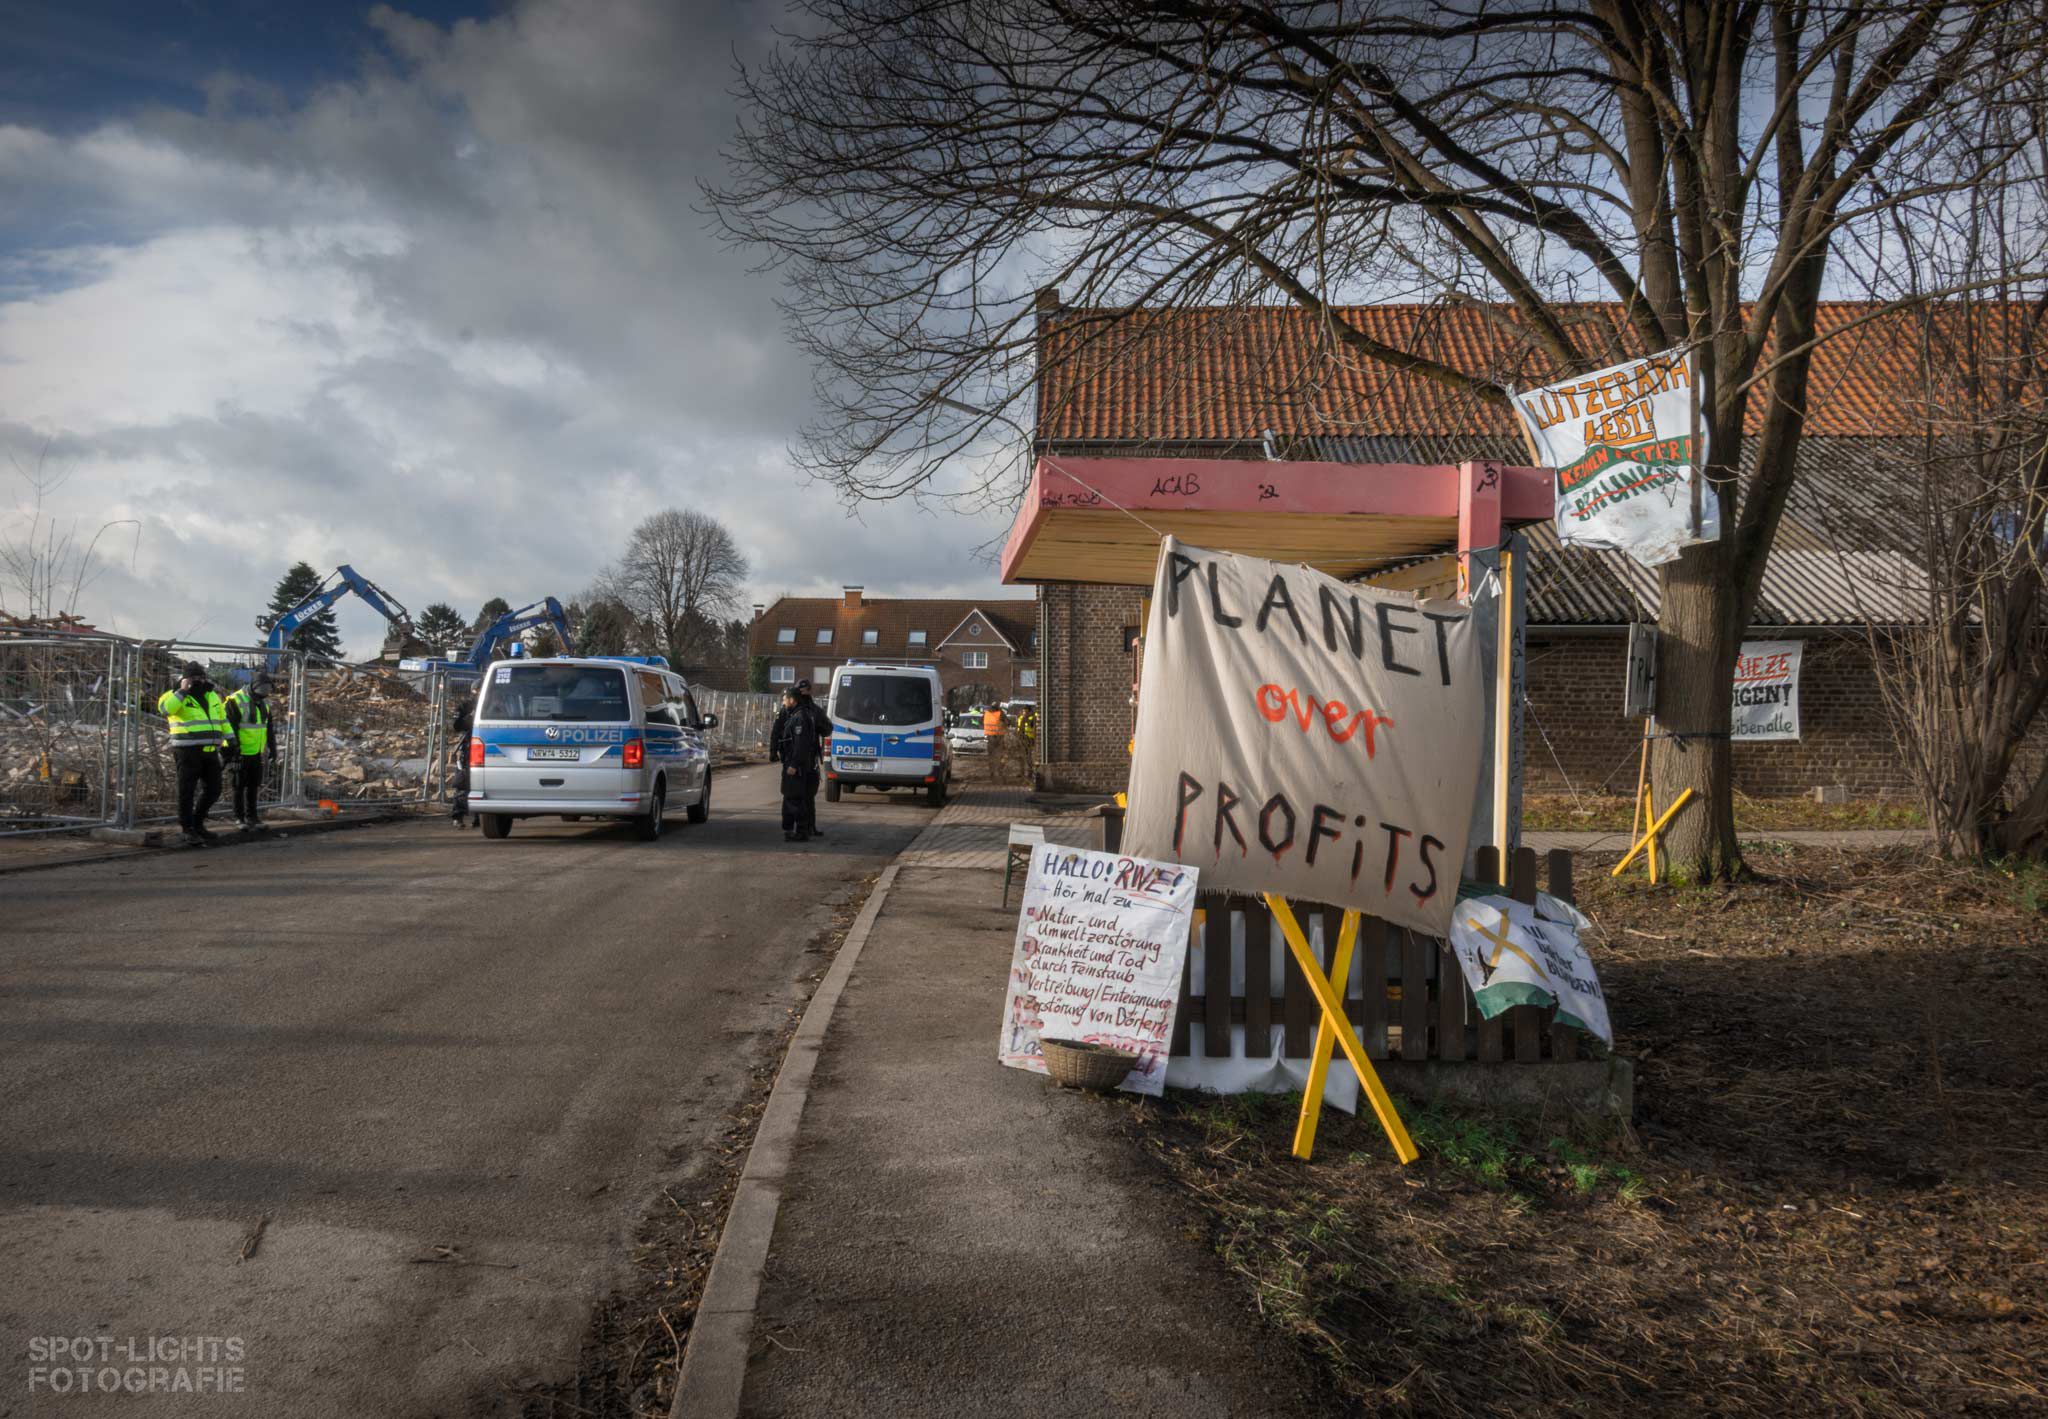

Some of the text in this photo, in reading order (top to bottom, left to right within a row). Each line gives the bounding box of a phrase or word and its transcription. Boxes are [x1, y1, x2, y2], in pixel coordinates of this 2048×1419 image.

[1584, 400, 1655, 446] LEBT!
[1151, 473, 1200, 497] ACAB
[1167, 552, 1464, 686] PLANET
[1733, 684, 1793, 706] IGEN!
[562, 729, 623, 743] POLIZEI
[1256, 684, 1394, 760] over
[836, 745, 877, 756] POLIZEI
[1043, 854, 1185, 895] HALLO! RWE!
[1054, 879, 1077, 898] Hör
[1113, 895, 1133, 908] zu
[1088, 914, 1119, 932] und
[1035, 939, 1147, 970] Krankheit und Tod
[1038, 923, 1162, 963] Umweltzerstörung
[1031, 957, 1136, 983] durch Feinstaub
[1024, 995, 1169, 1036] Zerstörung von Dörfern
